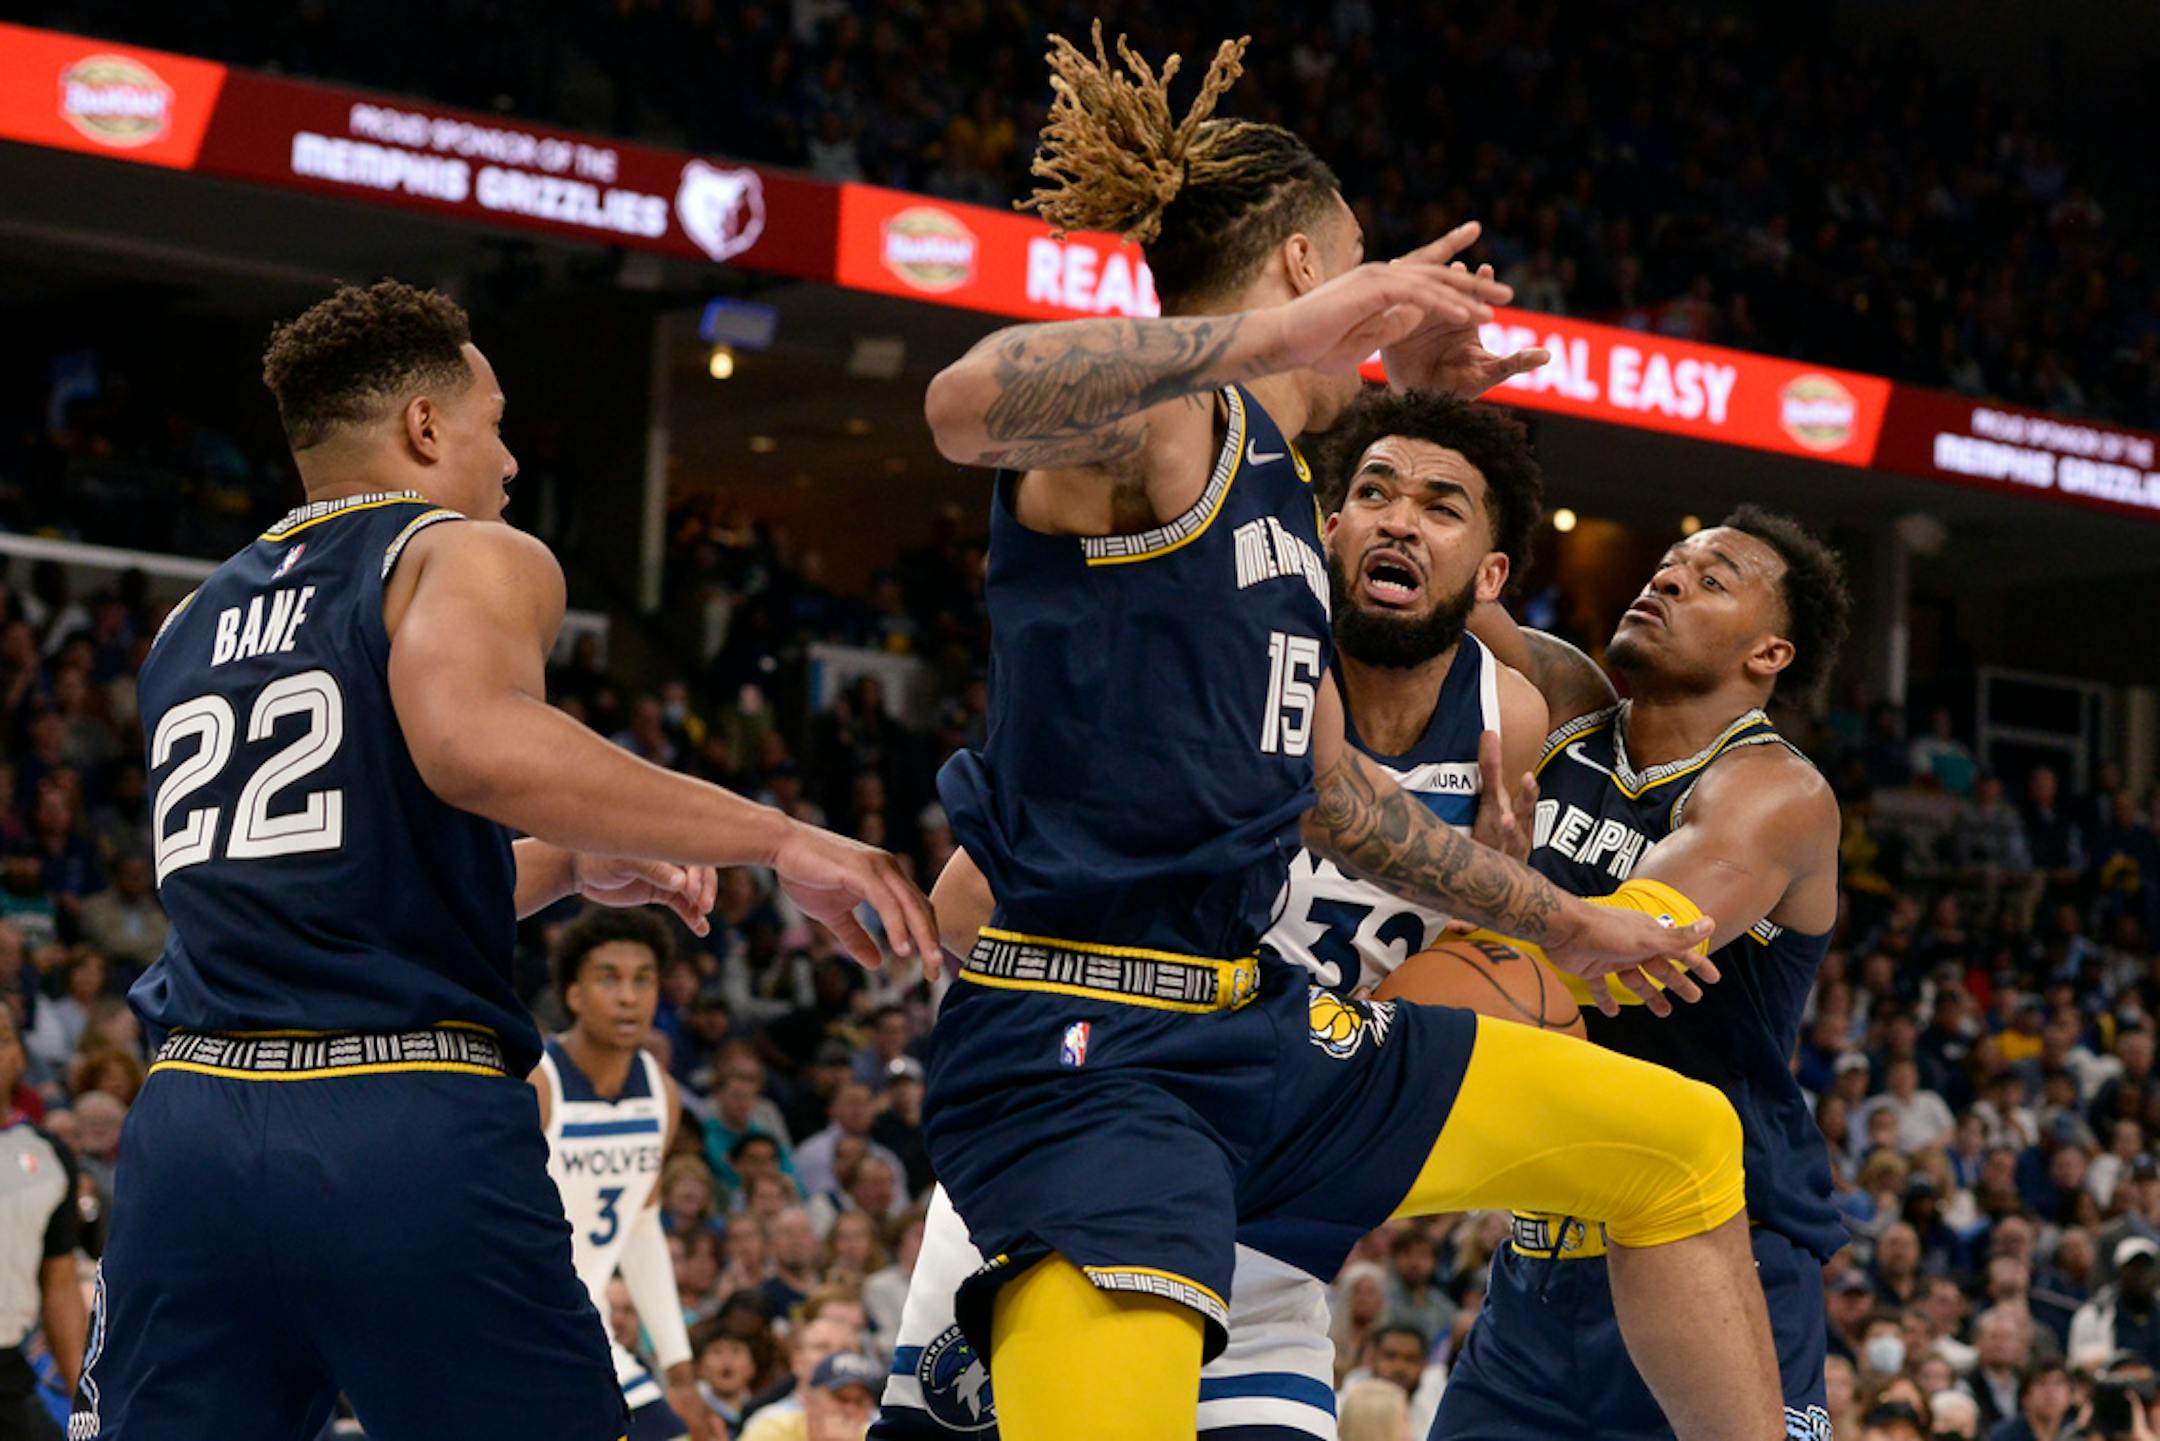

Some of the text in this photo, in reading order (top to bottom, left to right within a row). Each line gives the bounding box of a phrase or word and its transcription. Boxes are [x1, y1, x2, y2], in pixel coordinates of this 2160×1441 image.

[291, 131, 668, 238] MEMPHIS GRIZZLIES
[1608, 344, 1737, 426] EASY
[1933, 432, 2055, 490] MEMPHIS
[211, 586, 315, 667] BANE
[1260, 630, 1321, 757] 15
[151, 669, 344, 890] 22
[588, 1186, 626, 1247] 3
